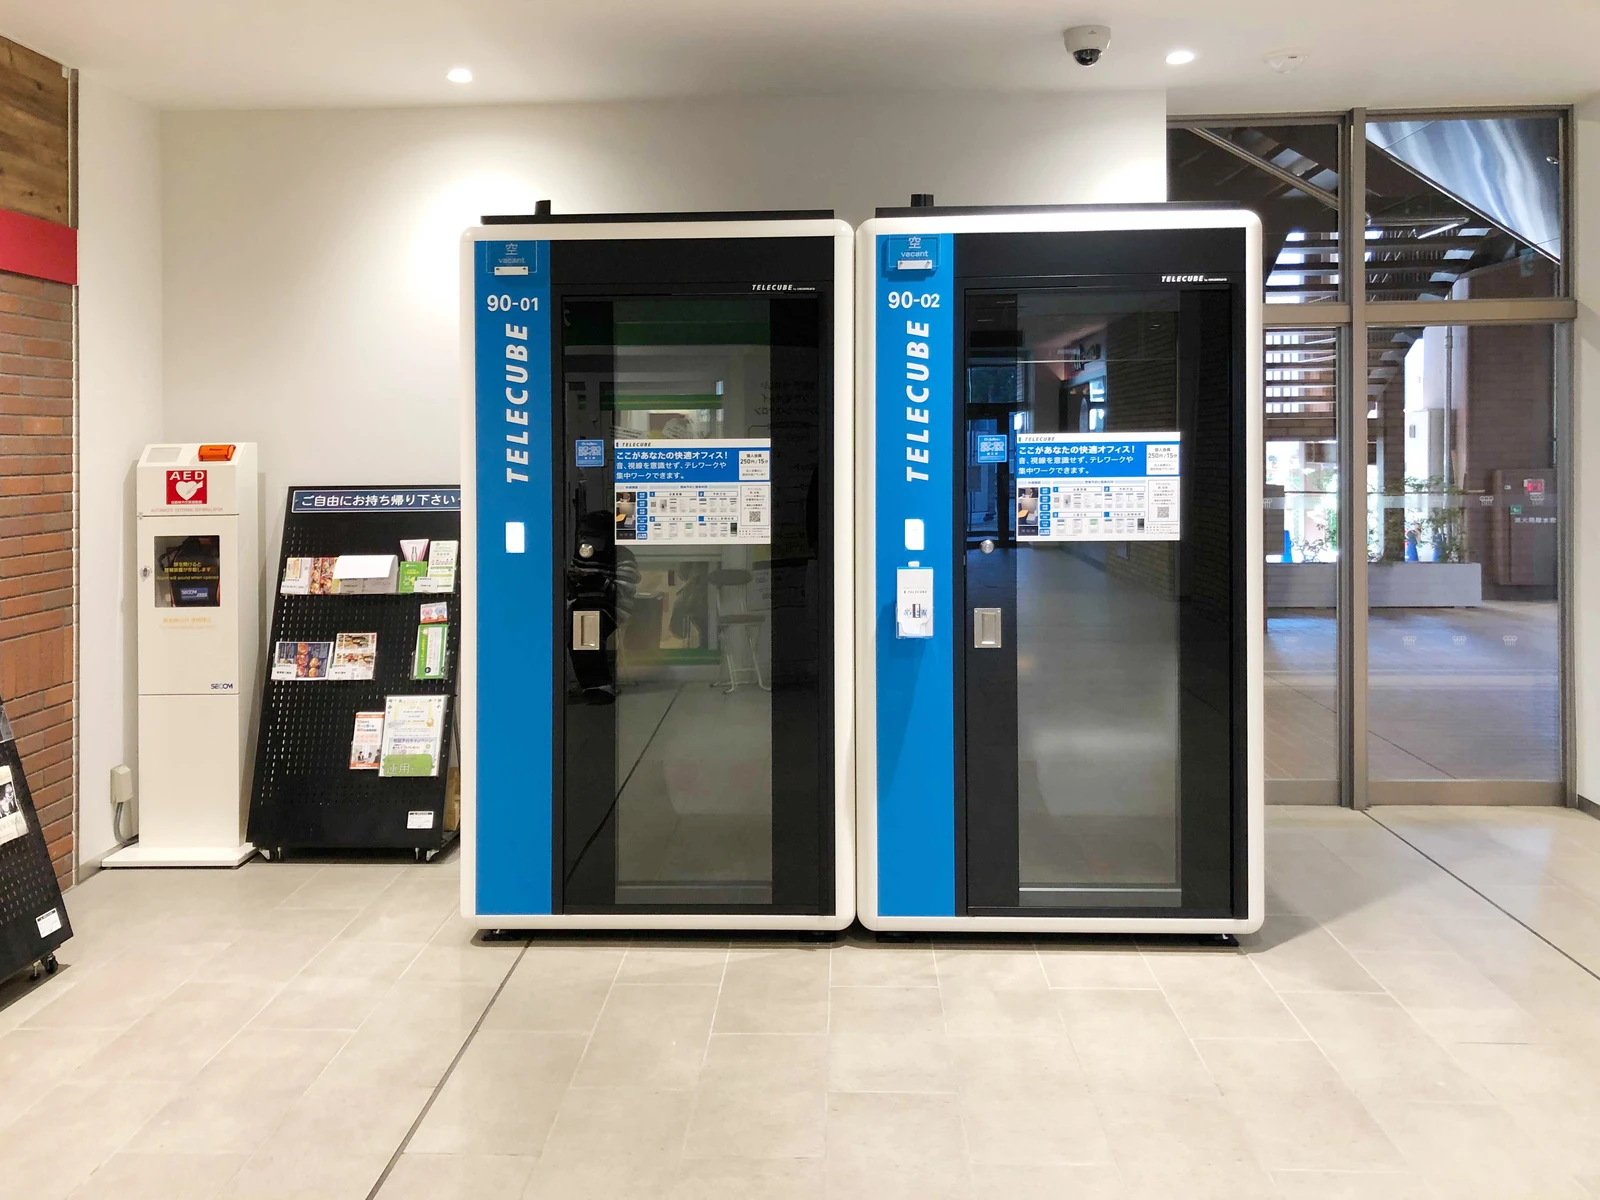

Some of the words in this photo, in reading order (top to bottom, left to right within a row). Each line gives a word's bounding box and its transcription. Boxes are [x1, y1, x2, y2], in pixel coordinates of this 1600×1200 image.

[908, 236, 921, 249] 空
[505, 243, 518, 256] 空
[1161, 275, 1204, 283] TELECUBE
[487, 294, 538, 312] 90-01
[888, 291, 940, 309] 90-02
[505, 323, 529, 484] TELECUBE
[906, 320, 930, 482] TELECUBE
[169, 471, 205, 480] AED
[616, 472, 685, 480] 集中ワークできます。
[1018, 467, 1090, 475] 集中ワークできます。
[302, 494, 455, 507] ご自由にお持ち帰り下さい
